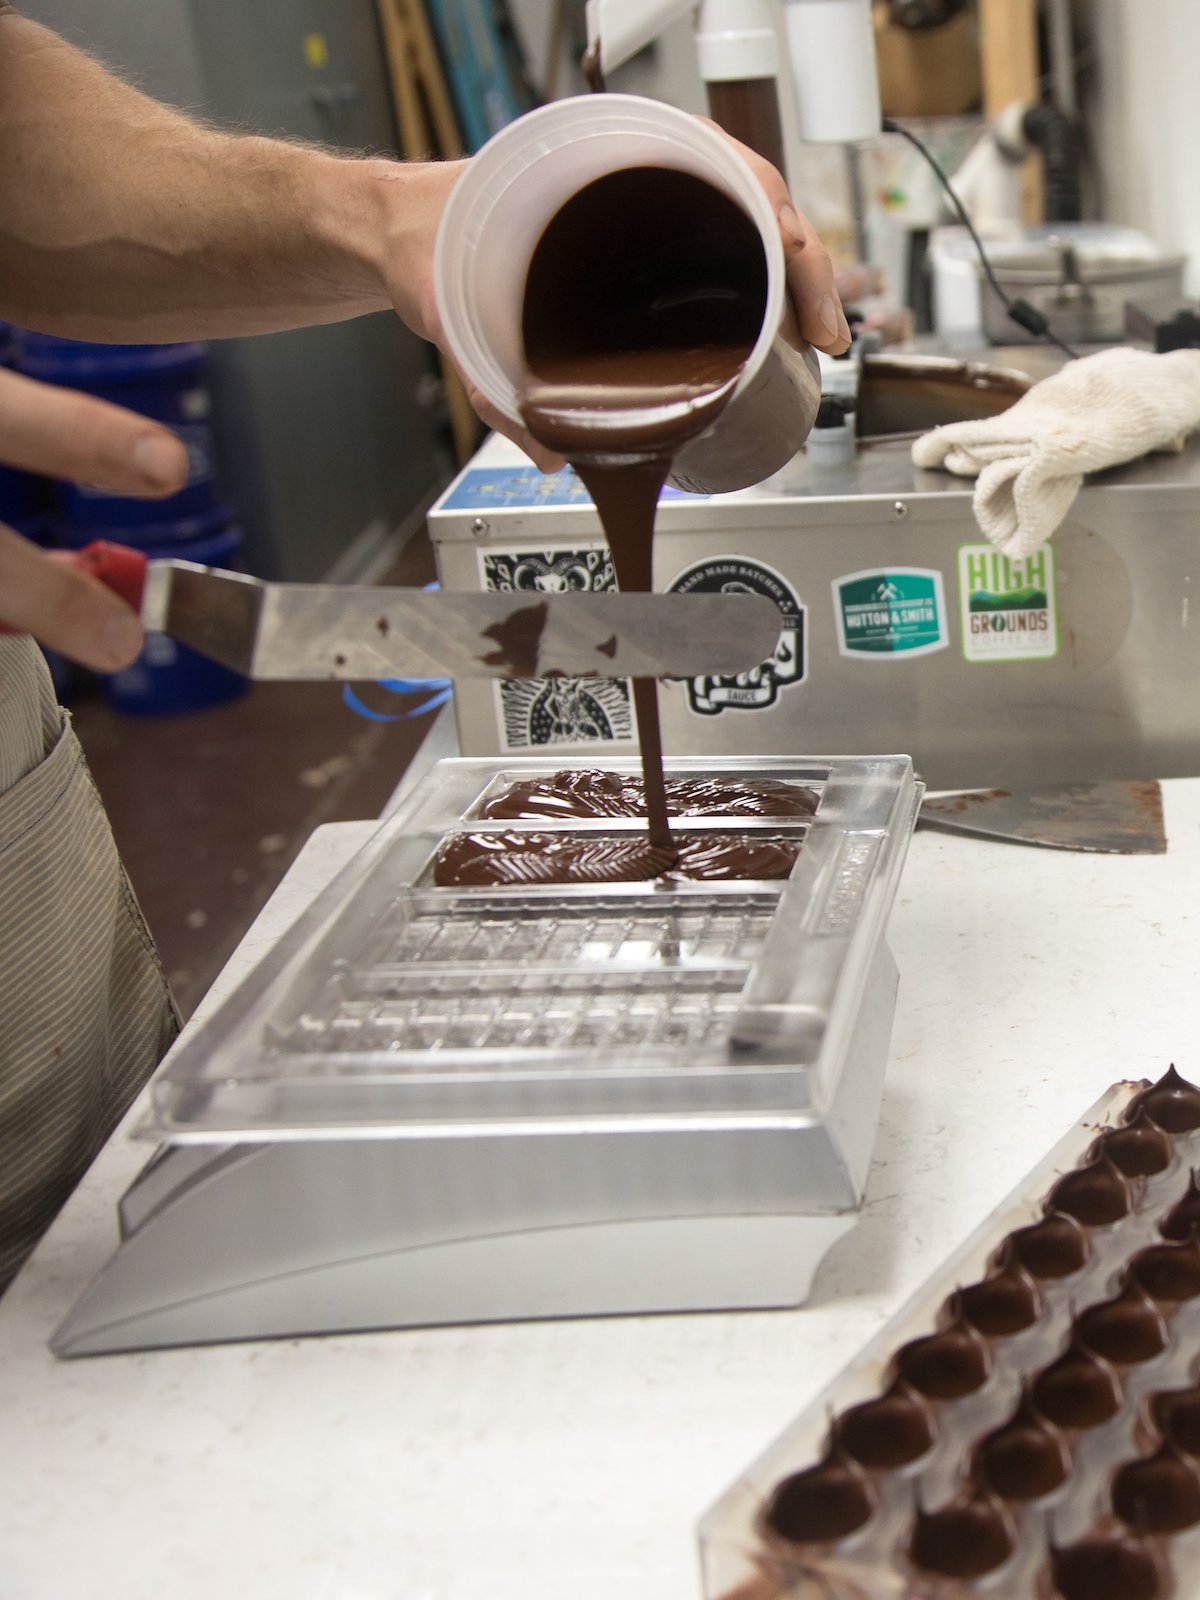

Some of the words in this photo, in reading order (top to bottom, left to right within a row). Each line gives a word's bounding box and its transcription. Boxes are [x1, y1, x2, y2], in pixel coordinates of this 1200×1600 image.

[677, 571, 705, 594] HAND
[704, 564, 737, 576] MADE
[967, 549, 1046, 593] HIGH
[846, 611, 890, 628] HUTTON
[891, 609, 900, 625] &
[901, 607, 934, 624] SMITH
[970, 610, 1048, 634] GROUNDS
[726, 689, 757, 701] SAUCE
